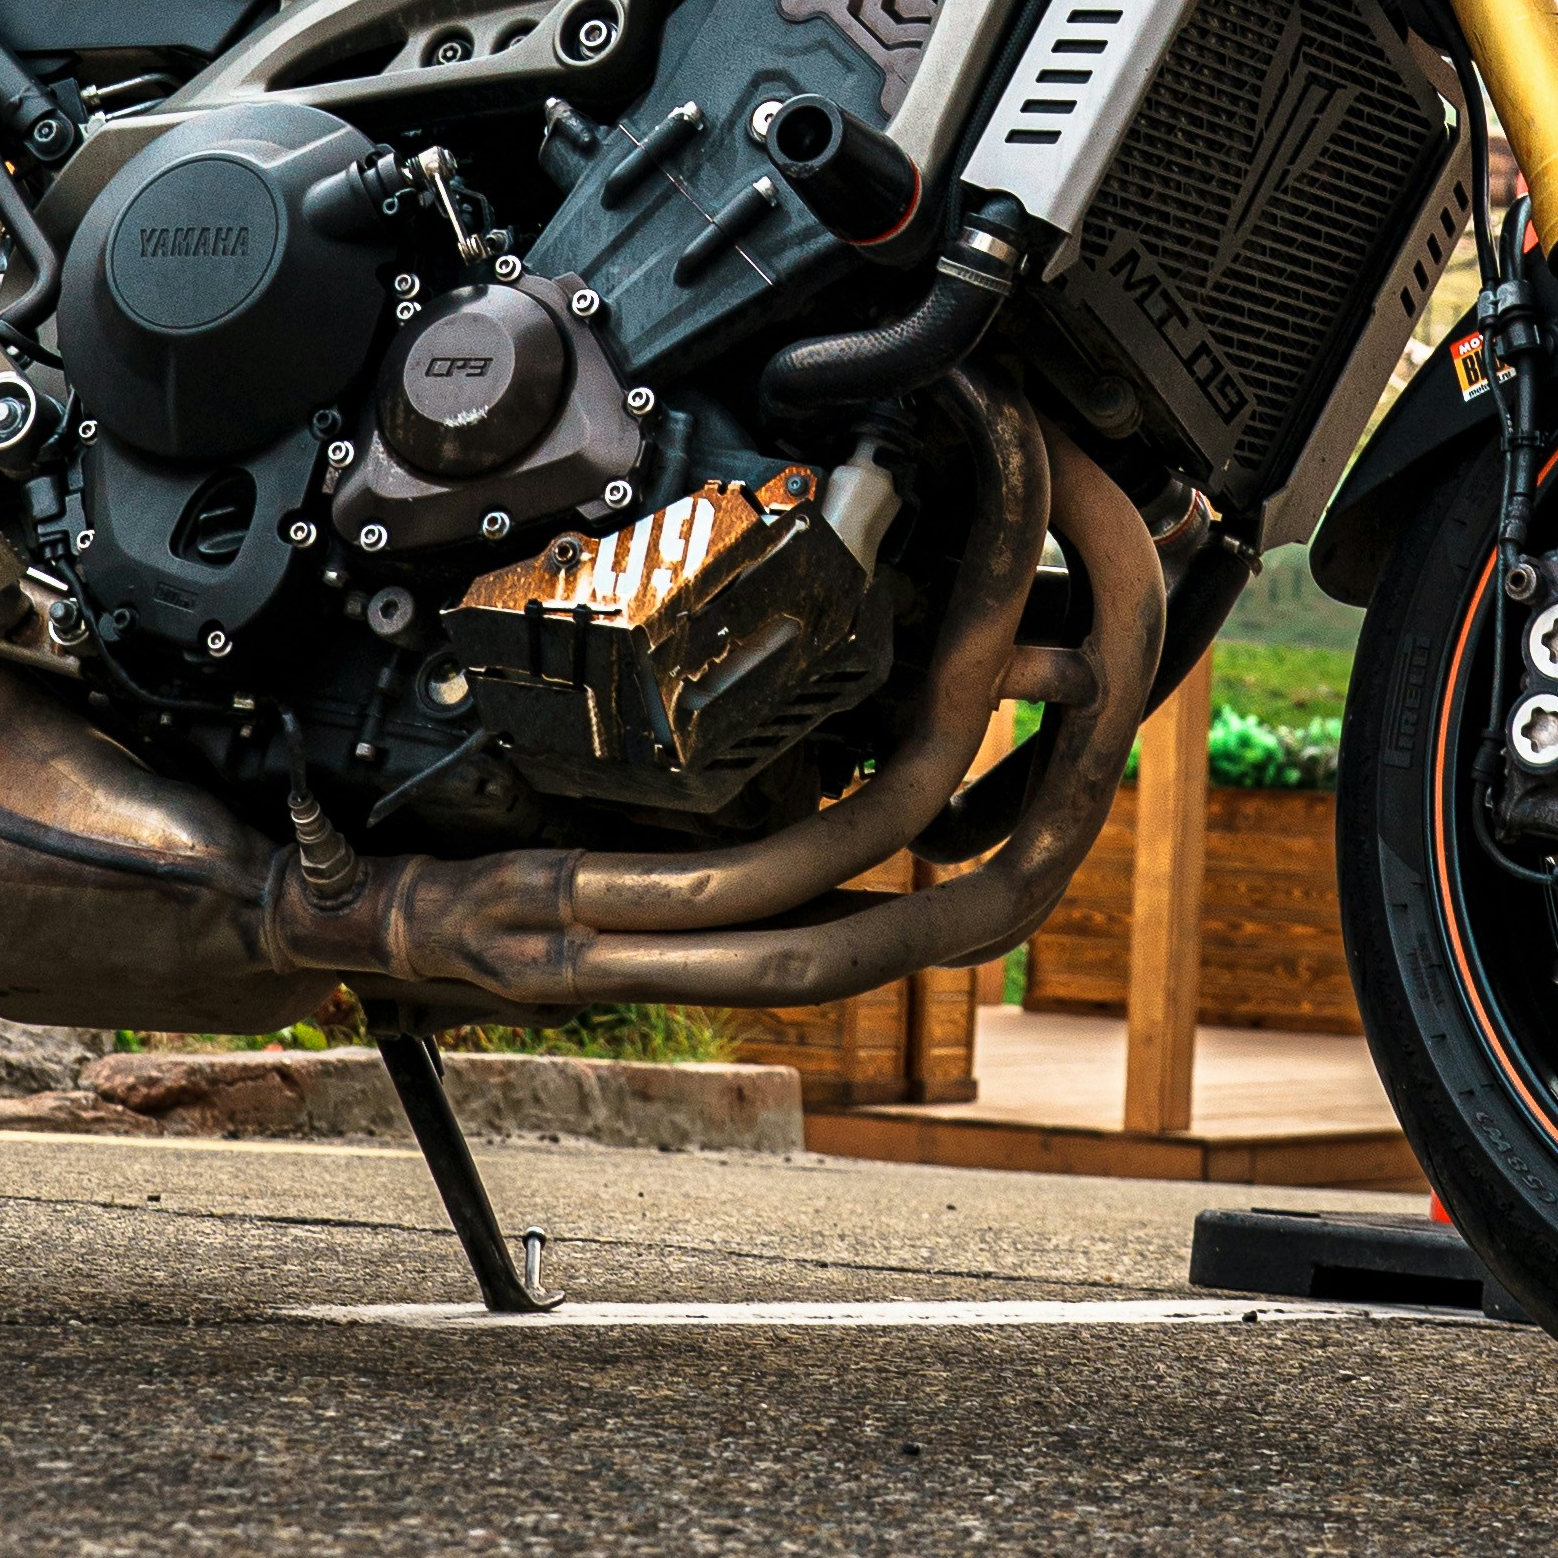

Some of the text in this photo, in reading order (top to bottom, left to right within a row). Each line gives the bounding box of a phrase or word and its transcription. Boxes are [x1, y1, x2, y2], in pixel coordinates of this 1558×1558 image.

[138, 226, 252, 257] YAMAHA
[423, 357, 494, 377] CP3
[591, 496, 716, 598] 09
[1381, 630, 1434, 770] PIRELLI
